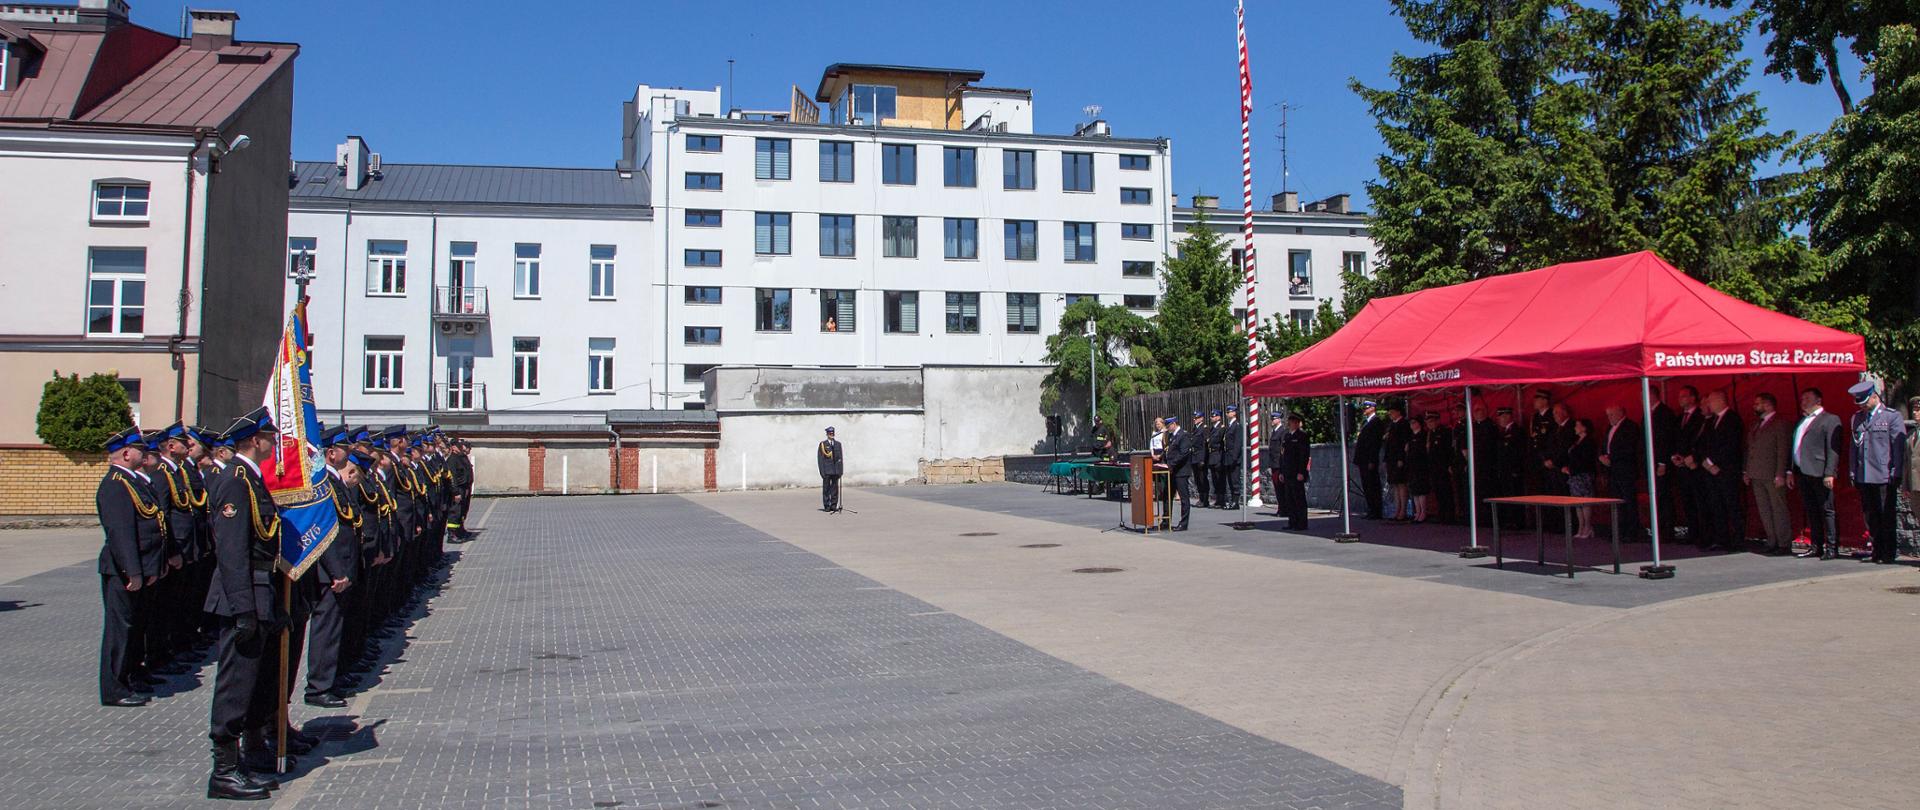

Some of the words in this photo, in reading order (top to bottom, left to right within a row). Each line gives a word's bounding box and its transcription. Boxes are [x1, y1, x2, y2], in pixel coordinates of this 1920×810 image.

[1654, 350, 1745, 367] Państwowa
[1750, 349, 1790, 365] Straż
[1794, 349, 1854, 365] Pożarna
[1343, 376, 1392, 387] Państwowa
[1395, 371, 1417, 385] Straż
[1420, 368, 1460, 382] Pożarna
[298, 523, 321, 552] 1875
